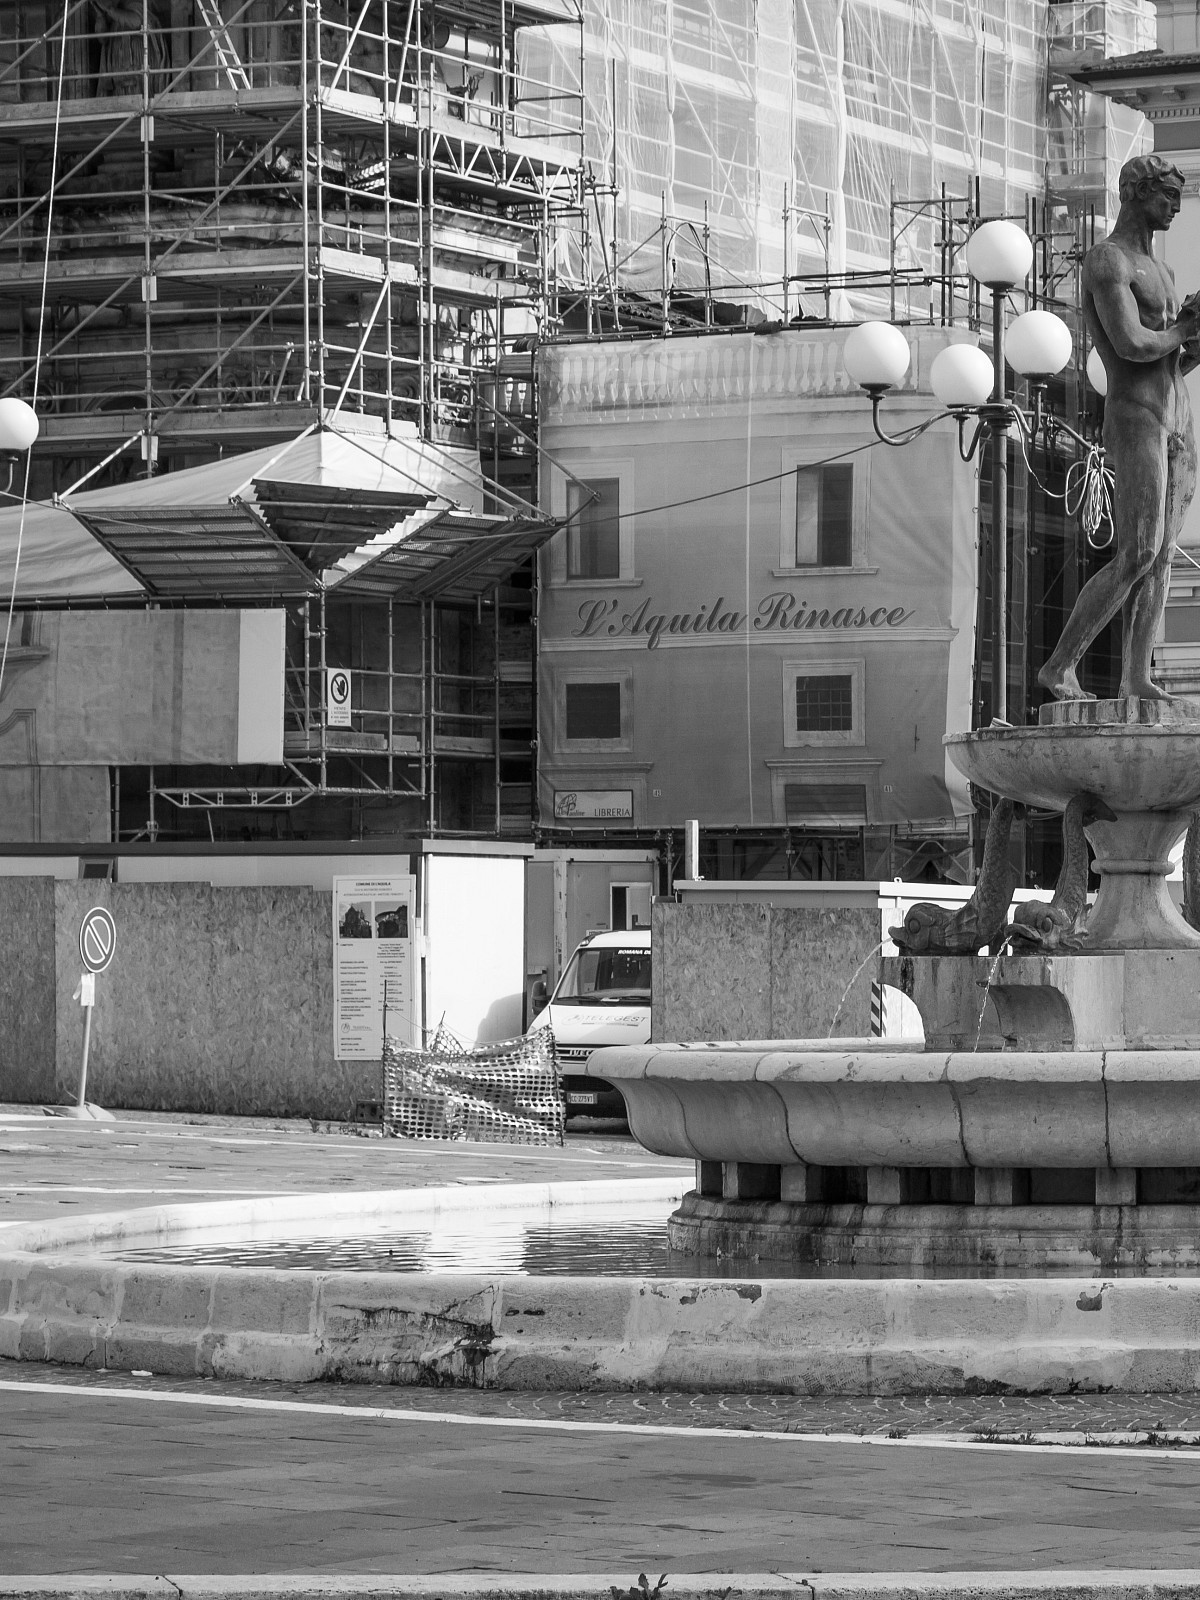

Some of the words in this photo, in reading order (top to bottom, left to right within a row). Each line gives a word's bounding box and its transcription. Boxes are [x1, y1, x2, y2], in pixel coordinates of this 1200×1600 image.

[571, 597, 748, 650] L'Aquila
[754, 591, 916, 631] Rinasce
[594, 807, 631, 817] LIBRERIA
[583, 1015, 649, 1023] TELEGEST
[570, 1049, 593, 1057] IVEC
